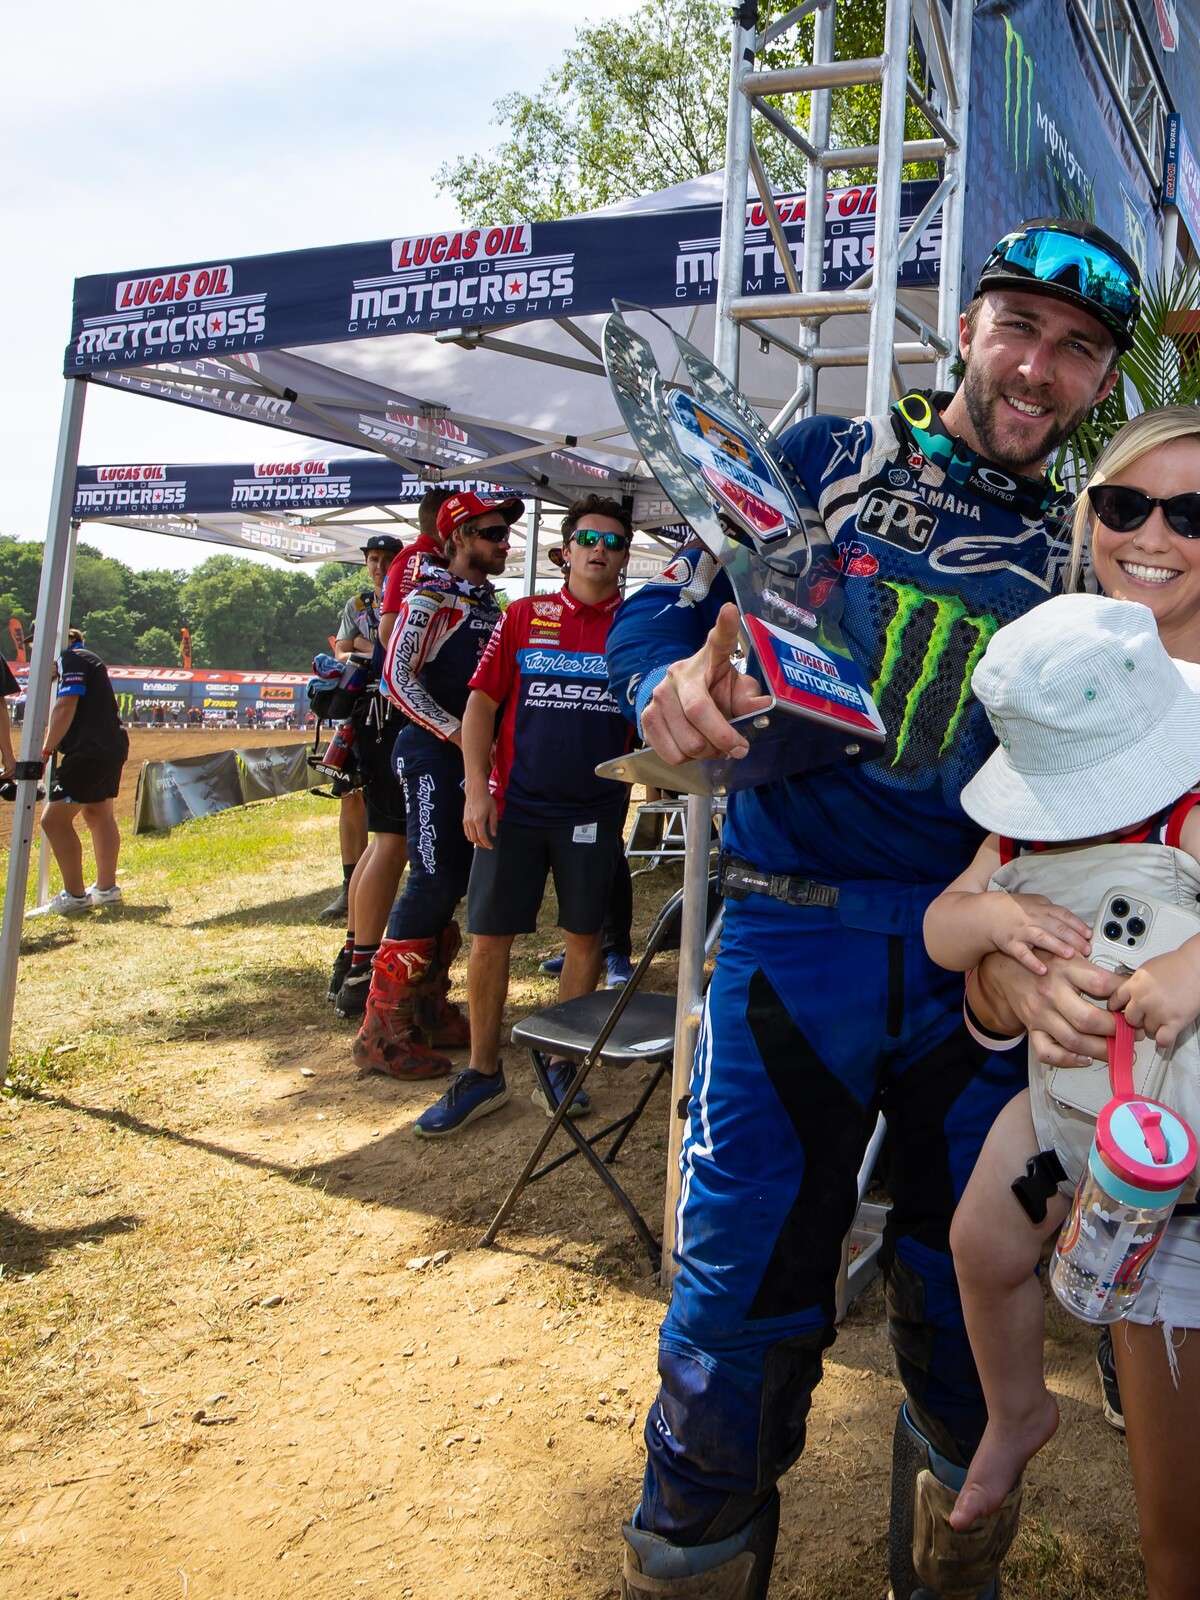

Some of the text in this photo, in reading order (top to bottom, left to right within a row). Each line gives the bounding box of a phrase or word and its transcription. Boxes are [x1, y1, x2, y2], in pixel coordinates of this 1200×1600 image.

[397, 224, 527, 268] LUCAS OIL
[430, 262, 490, 280] PRO
[120, 267, 229, 307] LUCAS OIL
[350, 266, 575, 320] MOTOCROSS
[147, 302, 197, 319] PRO
[348, 297, 574, 333] CHAMPIONSHIP
[77, 304, 266, 355] MOTOCROSS
[75, 333, 265, 367] CHAMPIONSHIP
[100, 465, 164, 481] LUCAS OIL
[257, 461, 327, 476] LUCAS OIL
[116, 481, 147, 489] PRO
[275, 476, 308, 485] PRO
[969, 475, 1015, 502] FACTORY PILOT
[76, 487, 187, 506] MOTOCROSS
[231, 483, 351, 502] MOTOCROSS
[715, 474, 778, 519] NATIONAL
[74, 503, 186, 513] CHAMPIONSHIP
[230, 498, 350, 509] CHAMPIONSHIP
[862, 497, 934, 543] PPG
[411, 612, 429, 626] PPG
[525, 651, 553, 673] Troy
[552, 653, 582, 672] Lee
[795, 650, 839, 678] LUCAS OIL
[205, 684, 239, 692] GEICO
[263, 689, 291, 698] KTM
[528, 681, 618, 704] GASGA
[783, 664, 862, 706] MOTOCROSS
[135, 699, 185, 708] MONSTER
[211, 700, 238, 708] THOR
[263, 702, 295, 710] Husqvarna
[524, 699, 581, 710] FACTORY
[315, 764, 350, 782] SENA
[417, 774, 437, 874] Troy Lee Designs
